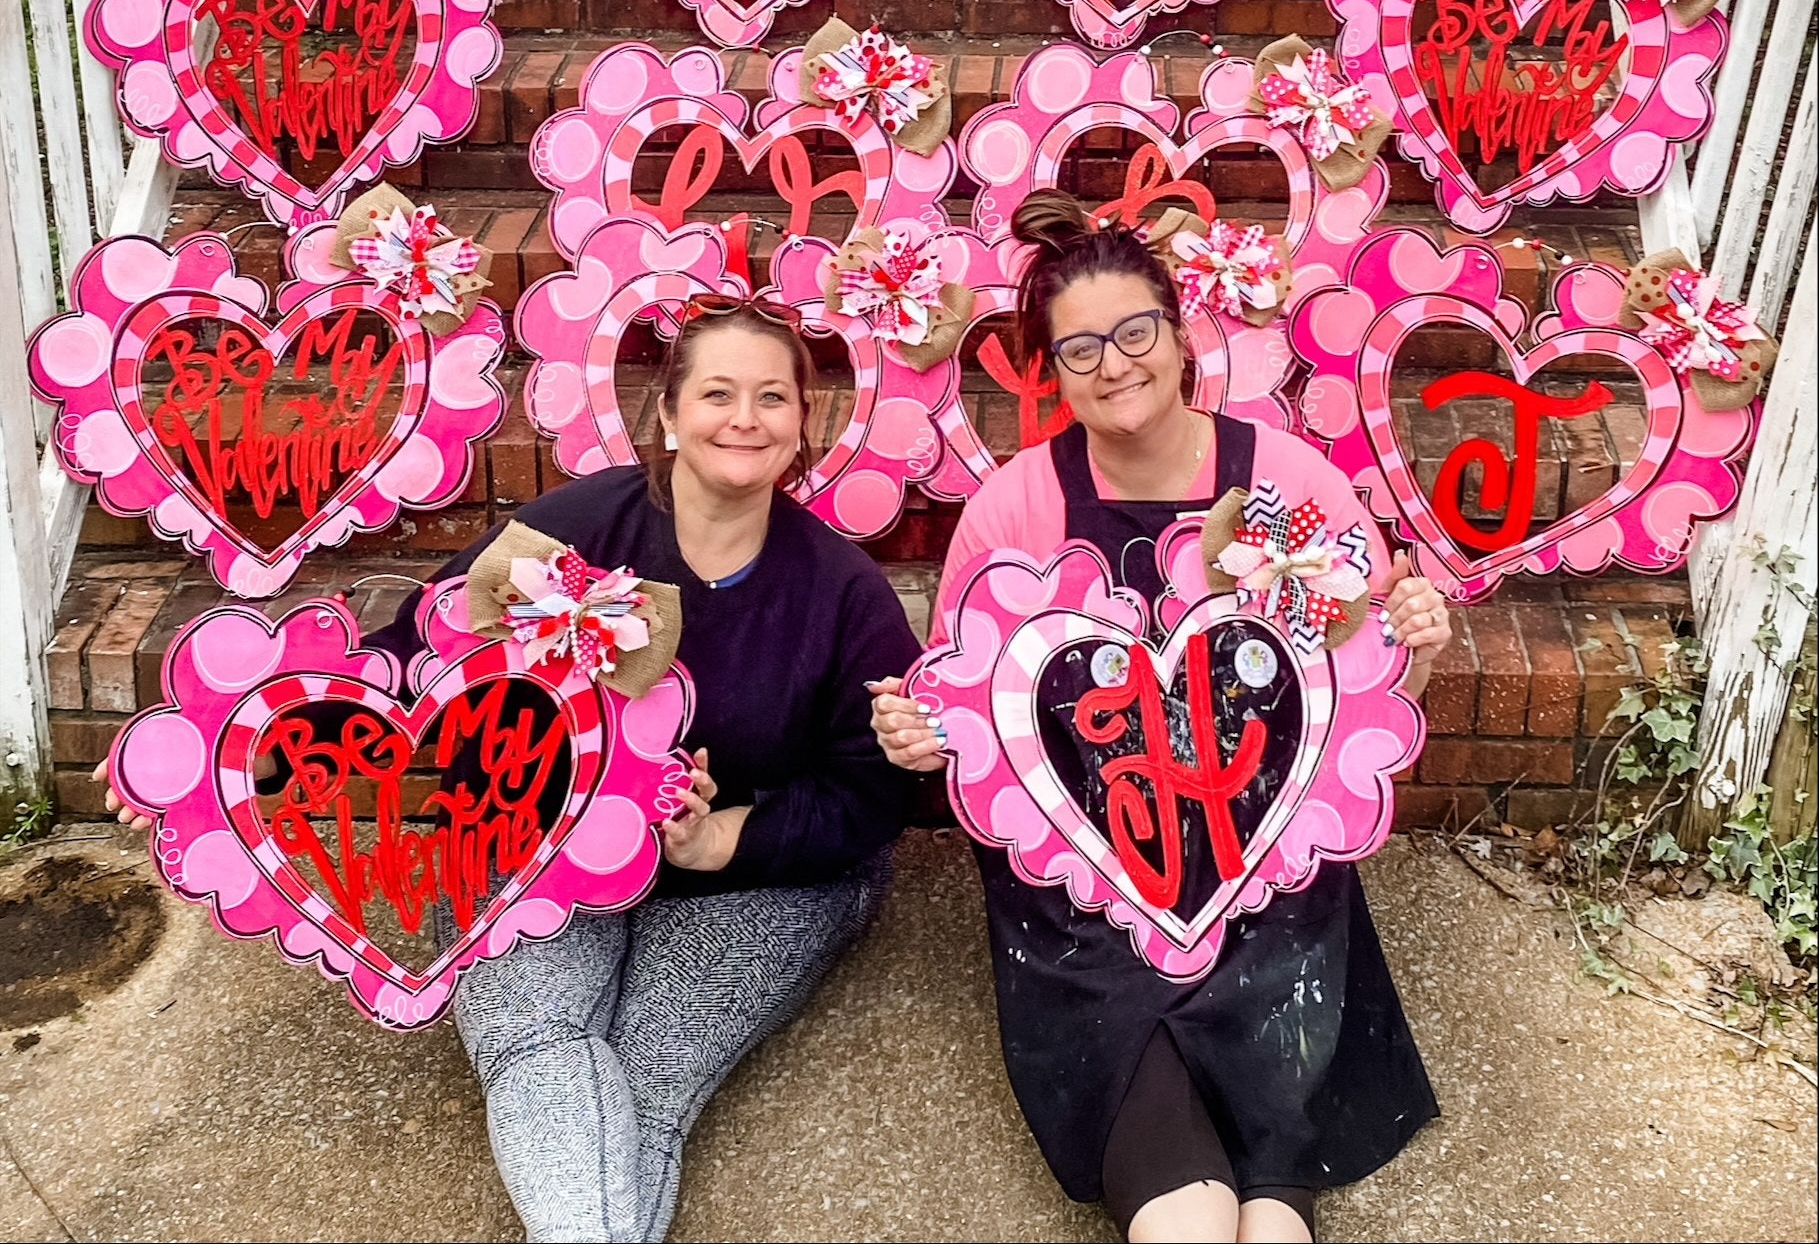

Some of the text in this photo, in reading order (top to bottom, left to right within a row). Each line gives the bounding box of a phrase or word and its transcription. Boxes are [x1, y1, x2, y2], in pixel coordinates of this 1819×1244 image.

[205, 41, 399, 161] Valentine
[1416, 43, 1595, 174] Valentine
[147, 309, 402, 418] Be My
[153, 386, 377, 520] Valentine
[256, 679, 568, 813] Be My
[1075, 634, 1267, 909] H
[271, 780, 542, 937] Valentine
